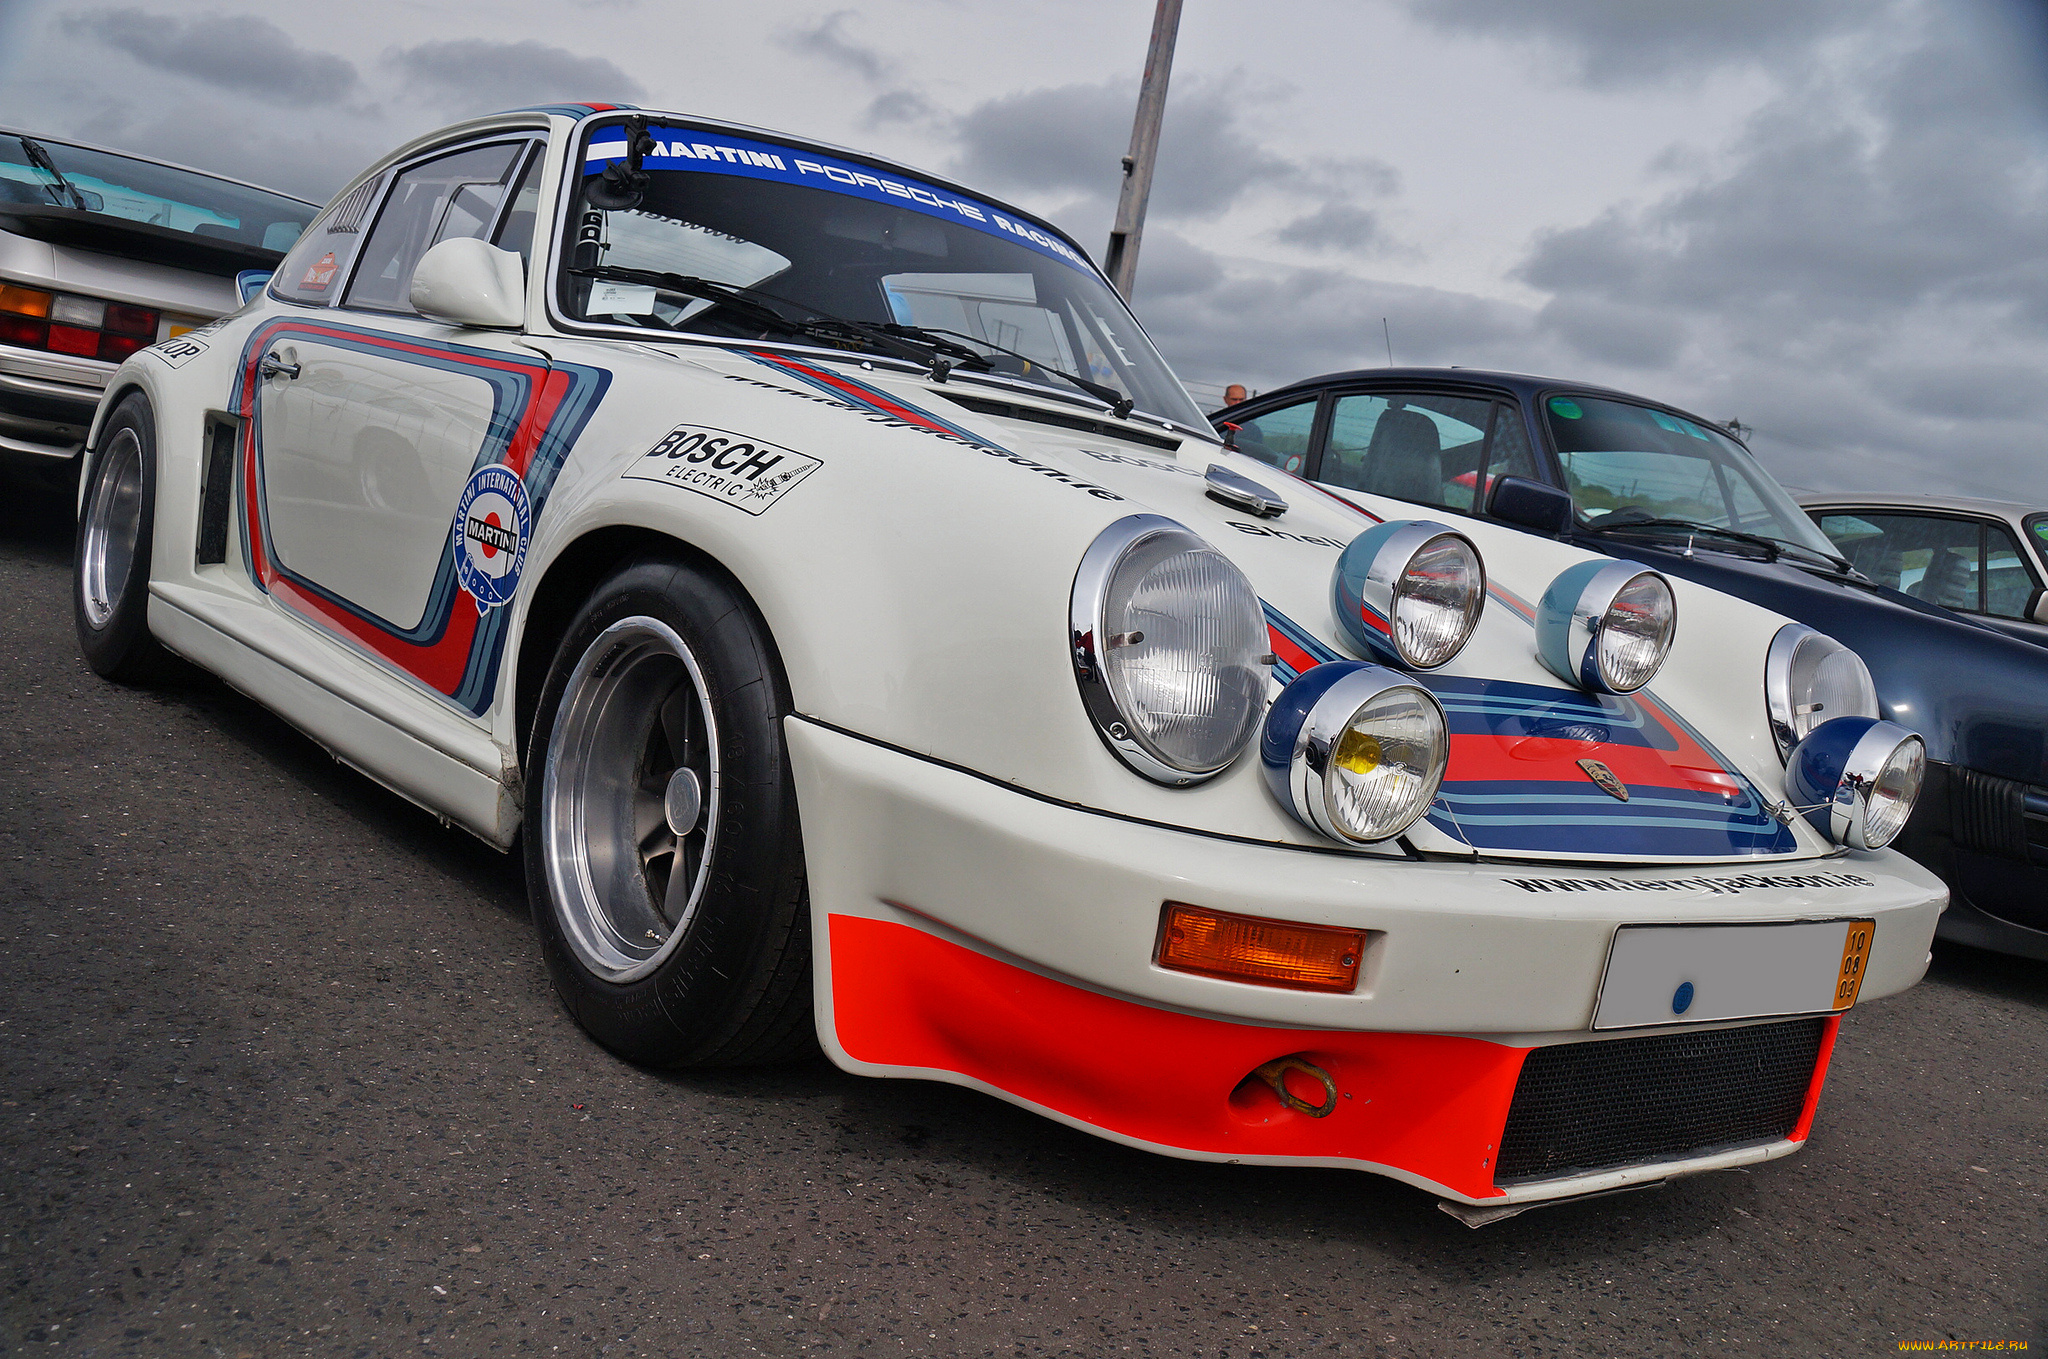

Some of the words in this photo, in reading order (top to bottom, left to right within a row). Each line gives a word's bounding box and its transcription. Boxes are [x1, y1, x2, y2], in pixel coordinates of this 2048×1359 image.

[646, 141, 786, 171] MARTINI
[794, 159, 987, 223] PORSCHE
[992, 214, 1088, 270] RACING
[150, 337, 201, 358] LOP
[646, 430, 785, 481] BOSCH
[1078, 449, 1204, 477] BOSC
[665, 465, 743, 496] ELECTRIC
[456, 483, 475, 547] MARTINI
[478, 472, 529, 530] INTERNATIONAL
[515, 536, 528, 577] CLUB
[469, 520, 516, 552] MARTINI
[1225, 521, 1347, 549] Shell
[1499, 870, 1875, 894] www.terryjackson.ie
[1849, 930, 1865, 952] 10
[1844, 954, 1860, 975] 08
[1839, 978, 1855, 999] 03
